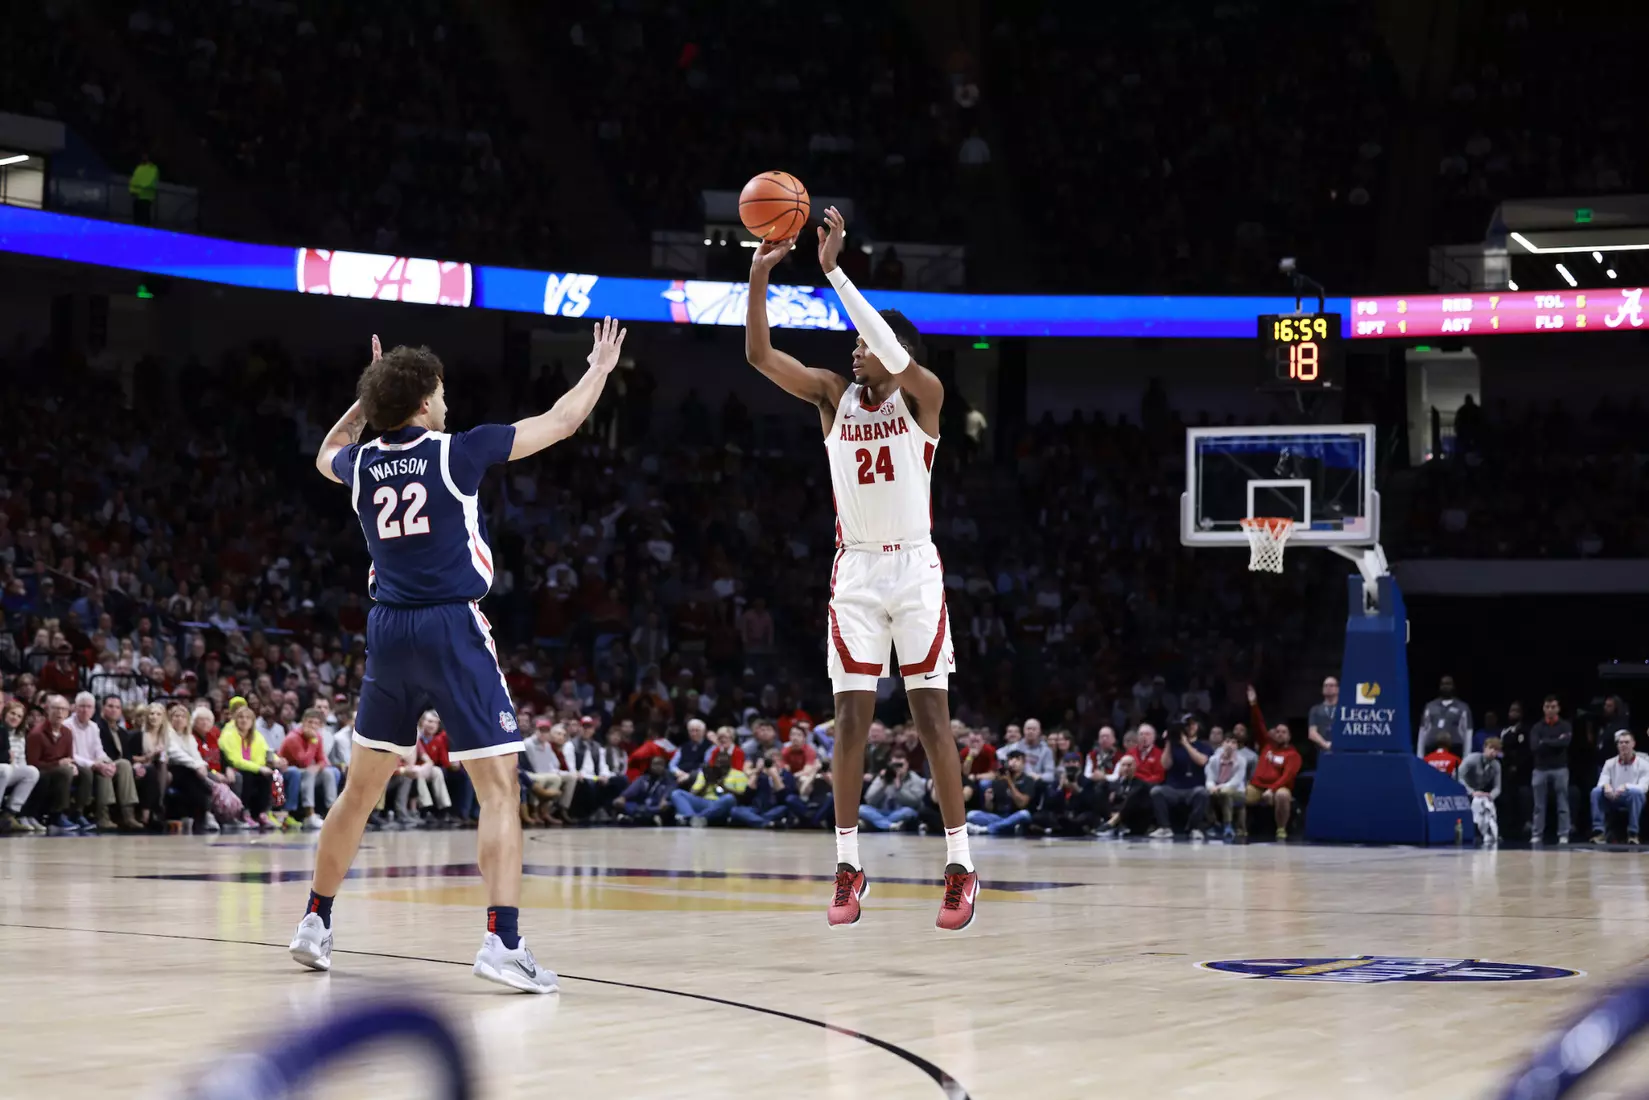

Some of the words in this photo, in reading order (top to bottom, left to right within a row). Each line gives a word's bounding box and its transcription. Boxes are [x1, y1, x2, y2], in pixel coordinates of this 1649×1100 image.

[543, 272, 599, 318] VS
[1489, 296, 1499, 310] 7
[1534, 295, 1565, 309] TOL
[1357, 301, 1378, 315] FG
[1397, 299, 1407, 314] 3
[1274, 318, 1327, 342] 16:59
[1357, 320, 1386, 335] 3PT
[1397, 319, 1407, 333] 1
[1441, 317, 1472, 332] AST
[1490, 315, 1499, 329] 1
[1535, 314, 1564, 329] FLS
[1576, 314, 1587, 328] 2
[1289, 341, 1318, 381] 18
[840, 416, 909, 442] ALABAMA
[368, 457, 428, 482] WATSON
[855, 445, 895, 485] 24
[372, 481, 431, 540] 22
[1340, 706, 1396, 722] LEGACY
[1342, 722, 1392, 736] ARENA
